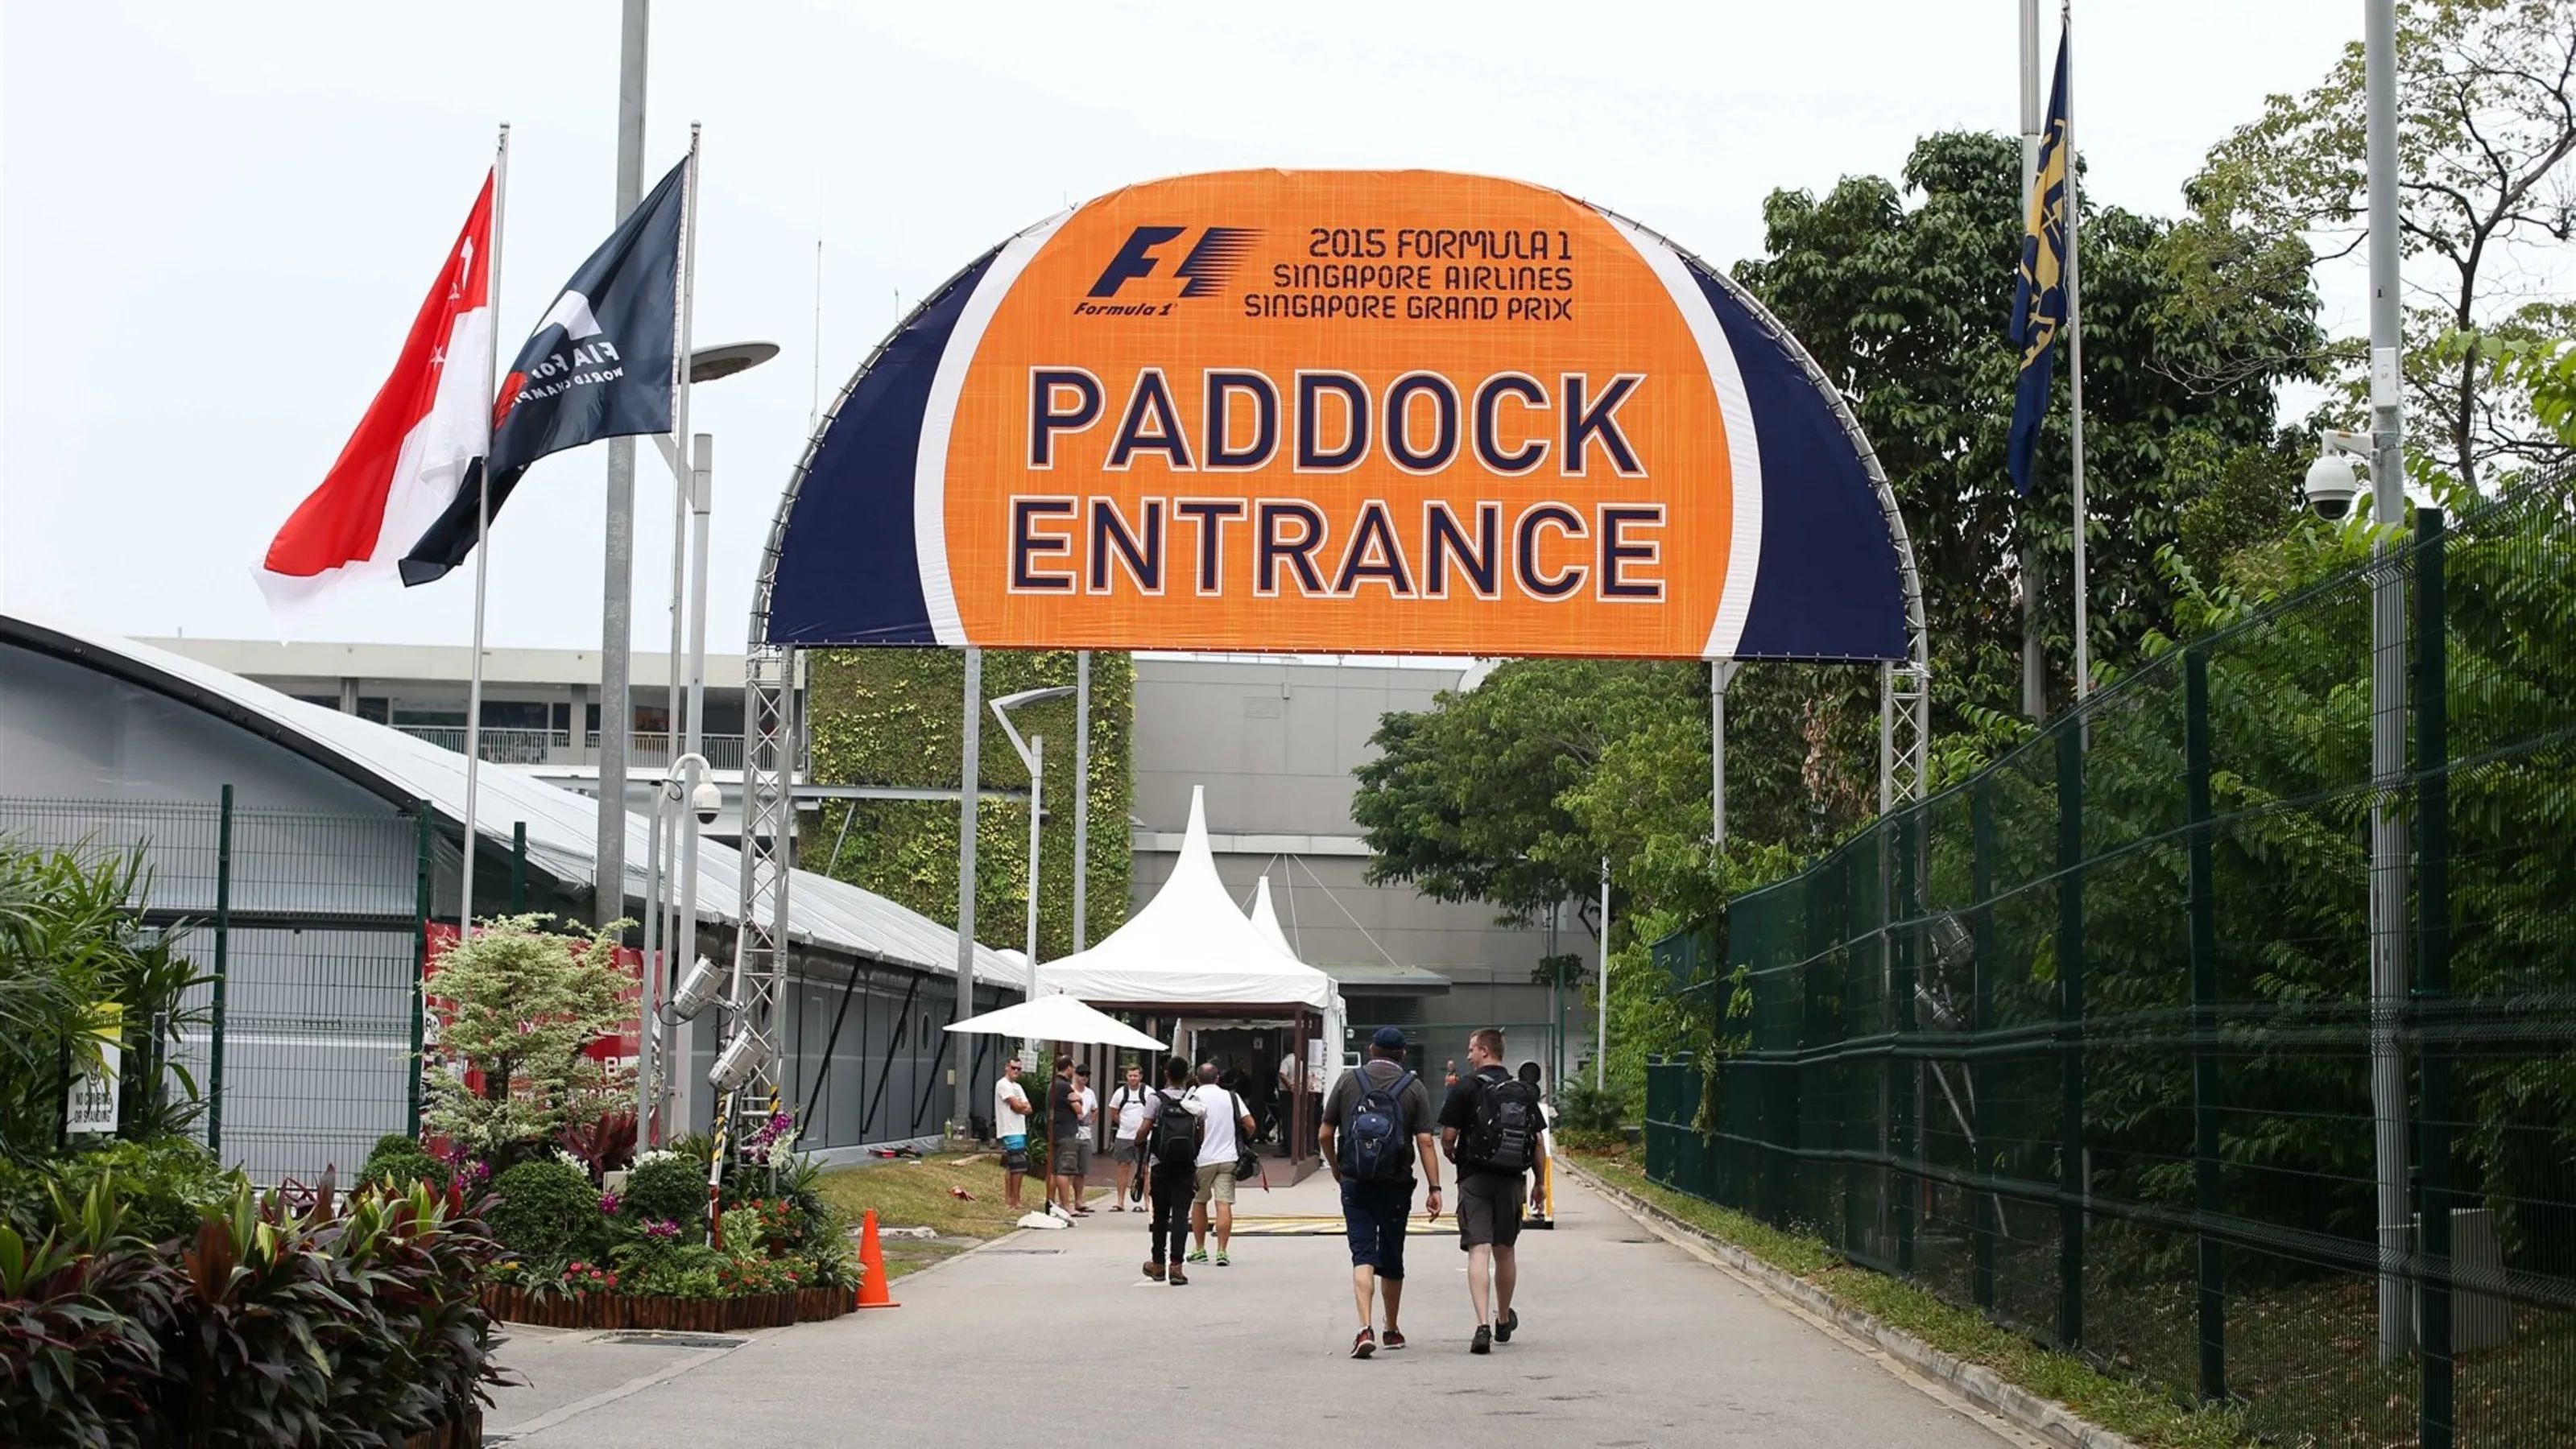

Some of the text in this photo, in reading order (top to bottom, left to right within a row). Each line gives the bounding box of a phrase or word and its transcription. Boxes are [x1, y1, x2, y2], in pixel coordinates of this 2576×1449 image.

[1309, 228, 1573, 260] 2015 FORMULA 1
[1273, 263, 1573, 291] SINGAPORE AIRLINES
[1073, 302, 1156, 316] Formula
[1244, 294, 1573, 320] SINGAPORE GRAND PRIX
[1026, 365, 1648, 479] PADDOCK
[1007, 493, 1666, 604] ENTRANCE
